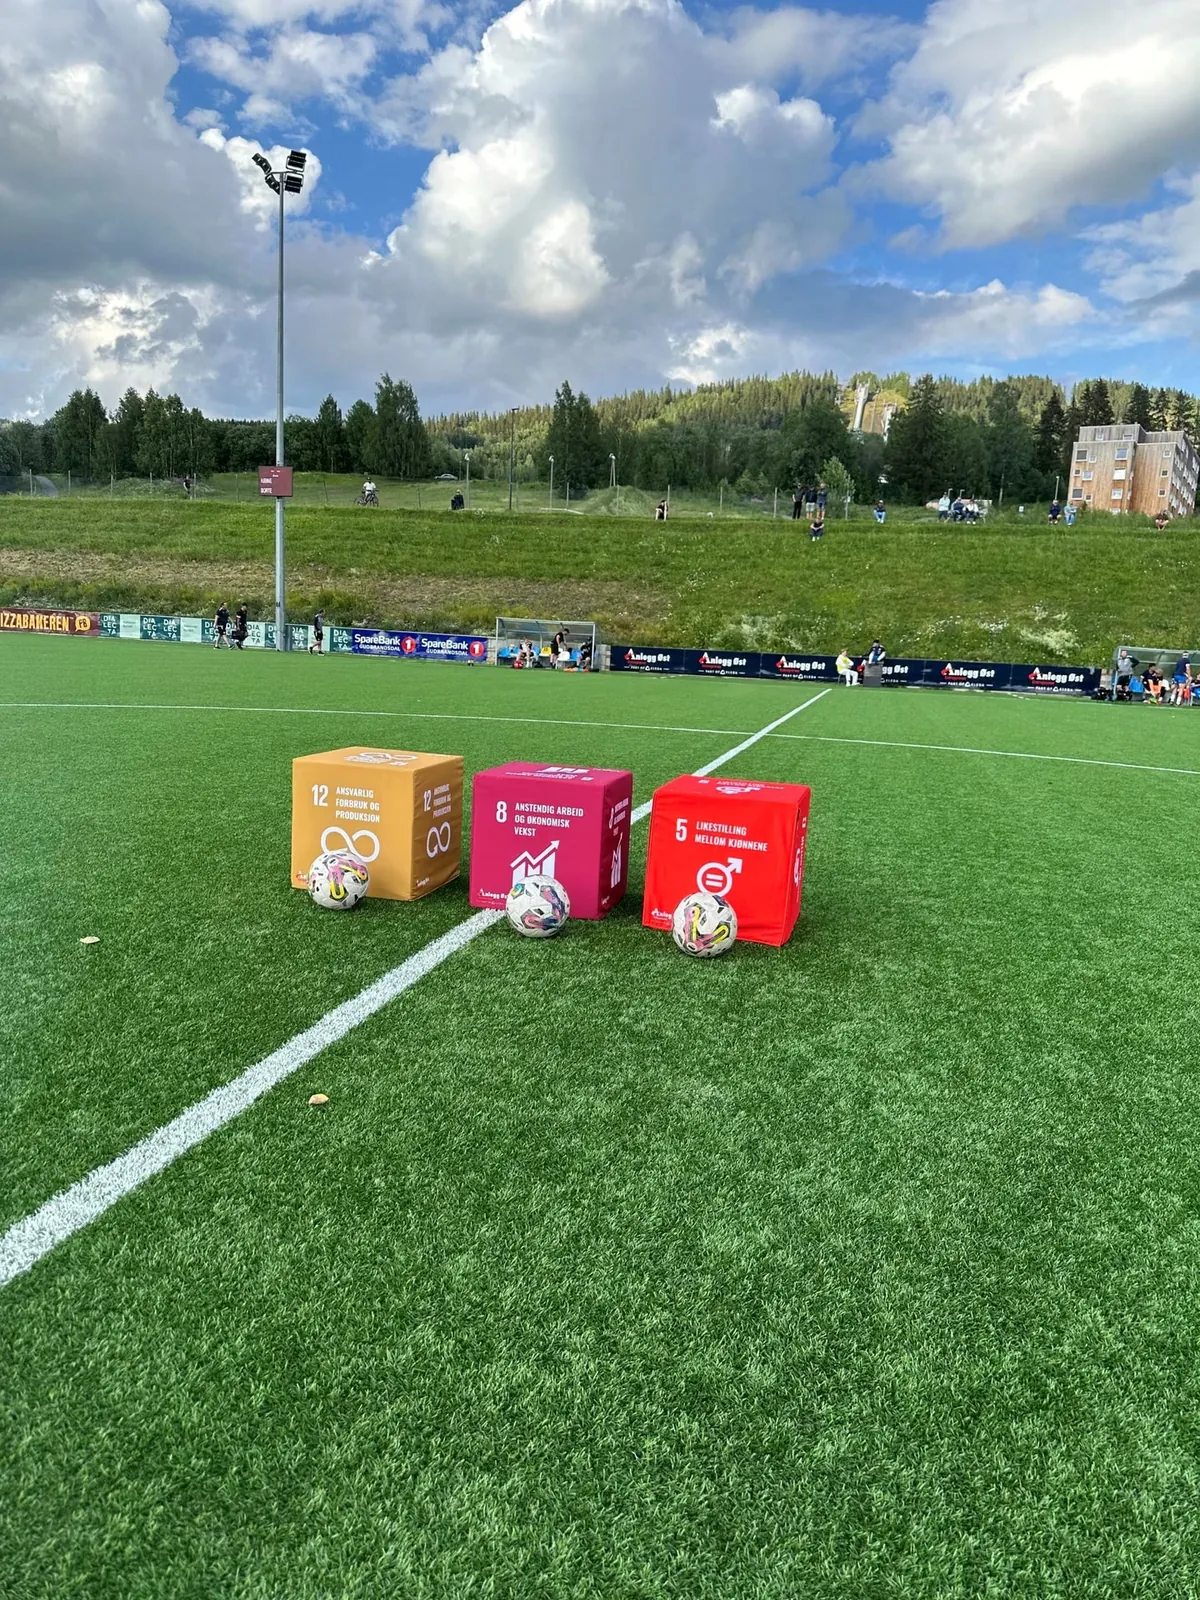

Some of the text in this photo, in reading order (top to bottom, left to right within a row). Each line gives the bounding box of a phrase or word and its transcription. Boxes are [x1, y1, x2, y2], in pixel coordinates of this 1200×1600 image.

[354, 634, 412, 650] SpareBank 1
[421, 638, 480, 654] SpareBank 1
[657, 653, 671, 662] Øst
[733, 657, 747, 666] Øst
[811, 661, 826, 670] Øst
[894, 665, 909, 674] Øst
[979, 668, 995, 678] Øst
[1068, 673, 1084, 682] Øst
[311, 784, 374, 807] 12 ANSVARLIG
[424, 789, 431, 812] 12
[335, 798, 380, 811] FORBRUK OG
[335, 810, 380, 823] PRODUKSJON
[496, 800, 584, 823] 8 ANSTENDIG ARBEID
[515, 815, 570, 828] OG ØKONOMISK
[514, 826, 536, 837] VEKST
[675, 818, 747, 842] 5 LIKESTILLING
[694, 834, 769, 852] MELLOM KJØNNENE
